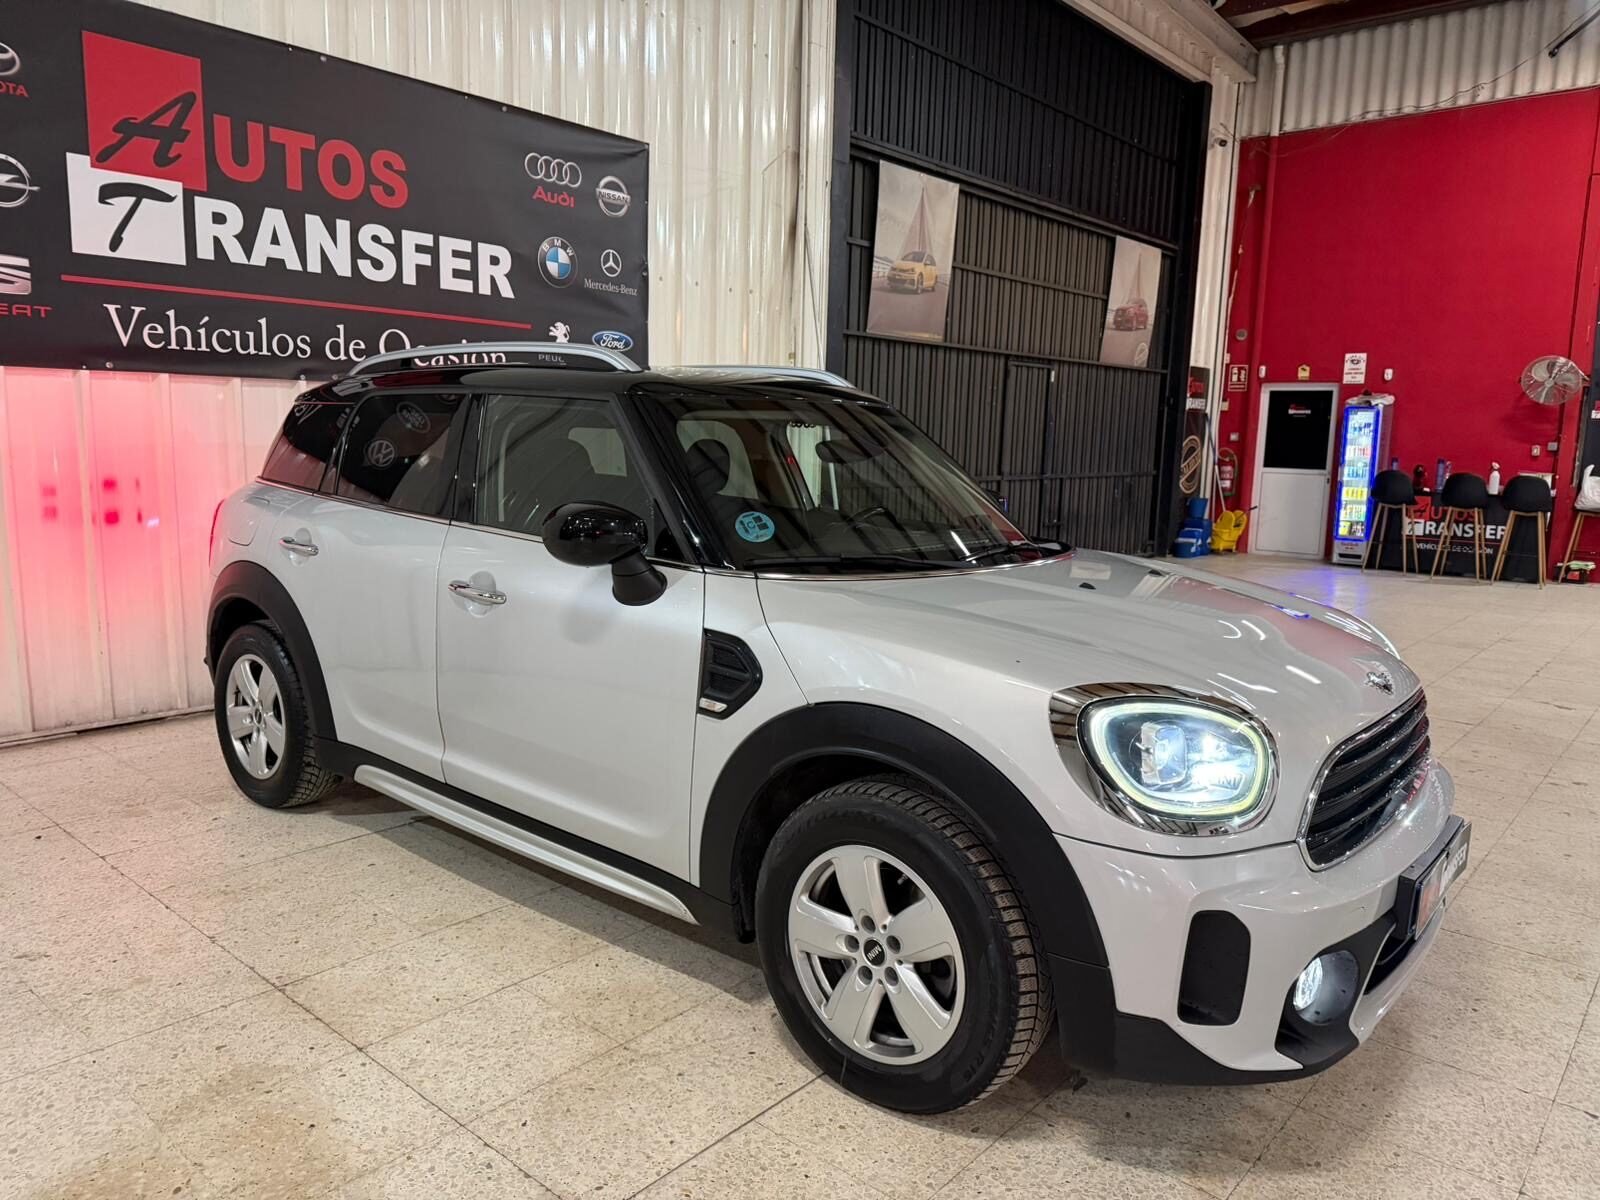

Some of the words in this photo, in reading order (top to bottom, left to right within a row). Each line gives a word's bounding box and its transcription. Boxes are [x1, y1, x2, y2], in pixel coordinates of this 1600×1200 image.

[0, 81, 28, 98] OTA
[95, 91, 409, 209] AUTOS
[532, 186, 575, 209] Audi
[598, 190, 630, 203] NISSAN
[98, 182, 515, 299] TRANSFER
[542, 238, 575, 257] BMW
[584, 278, 638, 296] Mercedes-Benz
[0, 303, 53, 318] EAT
[103, 303, 311, 359] Vehículos
[324, 324, 366, 361] de
[600, 333, 626, 350] Ford
[866, 944, 883, 961] MINI
